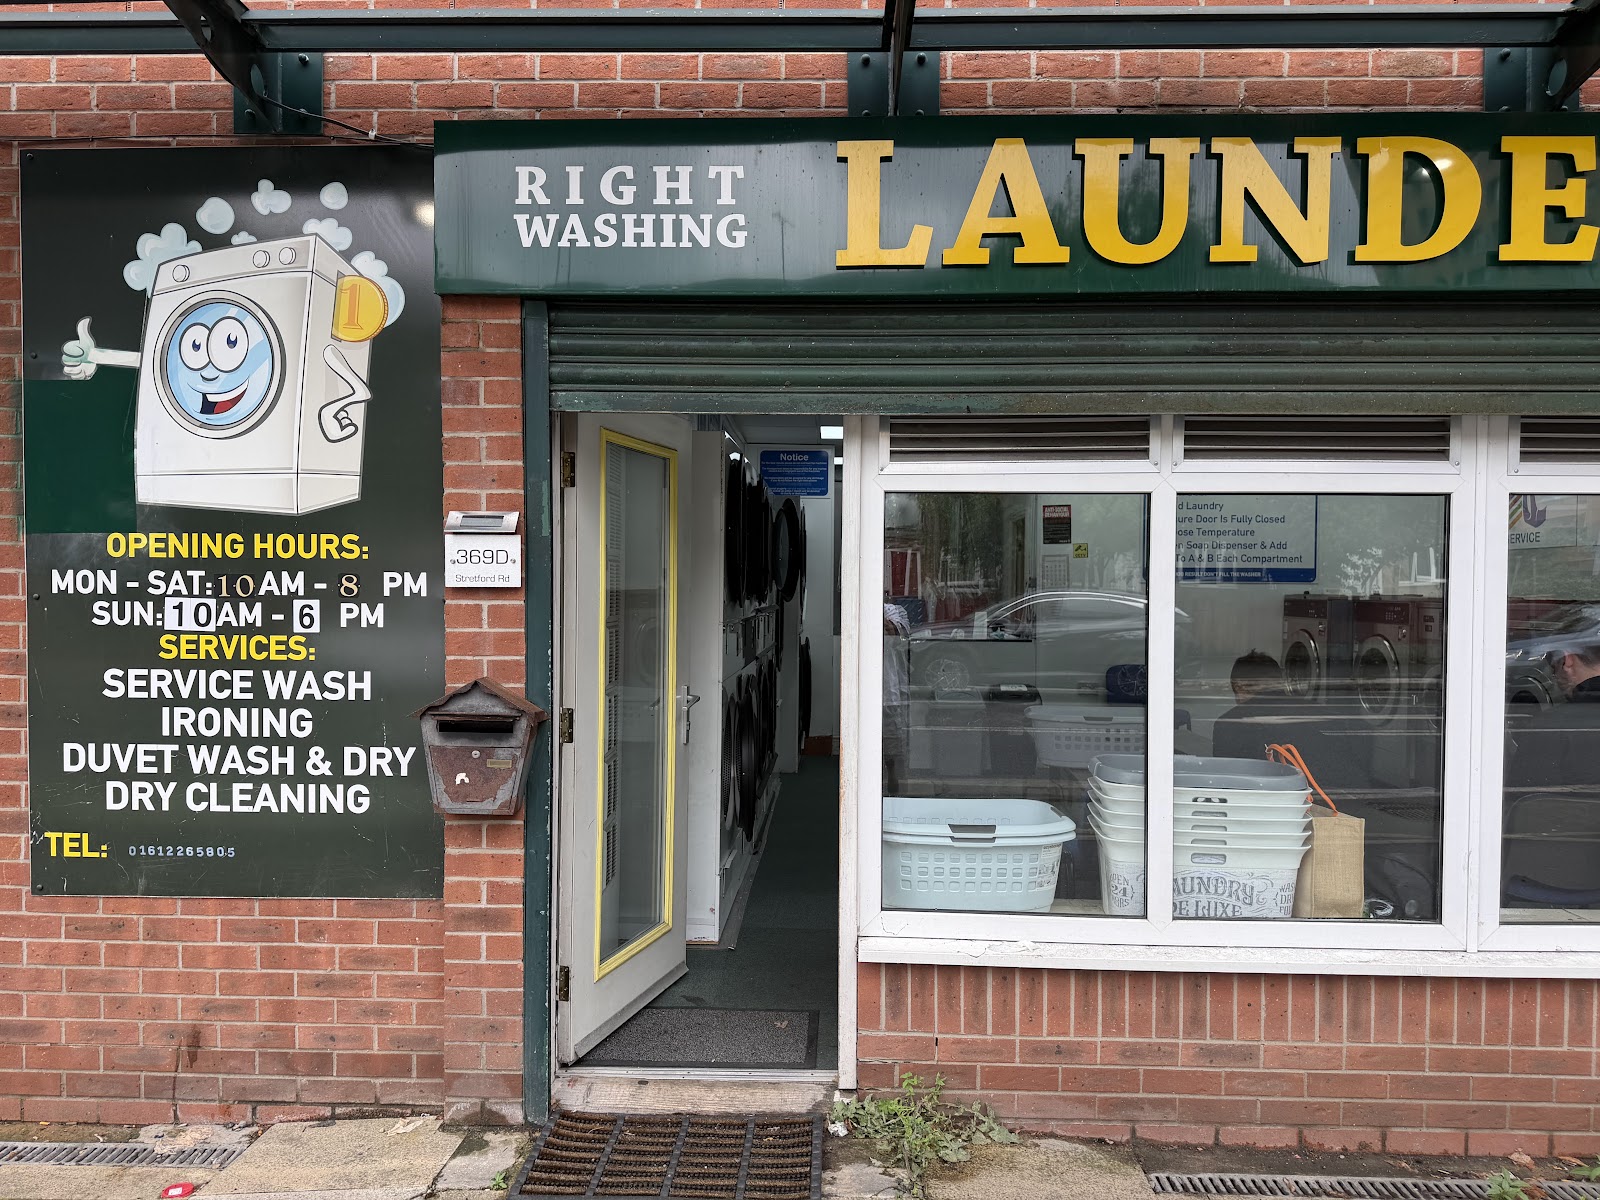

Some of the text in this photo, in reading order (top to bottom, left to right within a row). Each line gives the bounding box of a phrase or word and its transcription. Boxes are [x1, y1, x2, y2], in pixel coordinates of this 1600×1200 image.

[515, 165, 744, 205] RIGHT
[835, 135, 1600, 267] LAUNDE
[513, 213, 748, 248] WASHING
[780, 453, 809, 461] Notice
[1186, 501, 1224, 512] Laundry
[1196, 514, 1217, 523] Door
[1220, 514, 1228, 523] Is
[1231, 514, 1253, 525] Fully
[1255, 514, 1286, 523] Closed
[107, 532, 369, 559] OPENING HOURS:
[1186, 540, 1209, 551] Soap
[1211, 540, 1258, 551] Dispenser
[1260, 540, 1267, 550] &
[1269, 540, 1288, 550] Add
[1196, 527, 1255, 538] Temperature
[456, 549, 509, 564] 369D
[1188, 553, 1196, 562] A
[1197, 553, 1205, 562] &
[1207, 553, 1214, 562] B
[1216, 553, 1238, 562] Each
[1240, 553, 1303, 564] Compartment
[51, 569, 117, 594] MON
[340, 574, 358, 597] 8
[383, 572, 427, 597] PM
[455, 574, 510, 583] Stretford Rd
[298, 603, 315, 629] 6
[340, 603, 384, 628] PM
[158, 634, 315, 660] SERVICES:
[102, 668, 371, 700] SERVICE WASH
[162, 706, 313, 738] IRONING
[63, 743, 416, 776] DUVET WASH & DRY
[106, 781, 370, 814] DRY CLEANING
[44, 832, 235, 858] TEL: 01612265805
